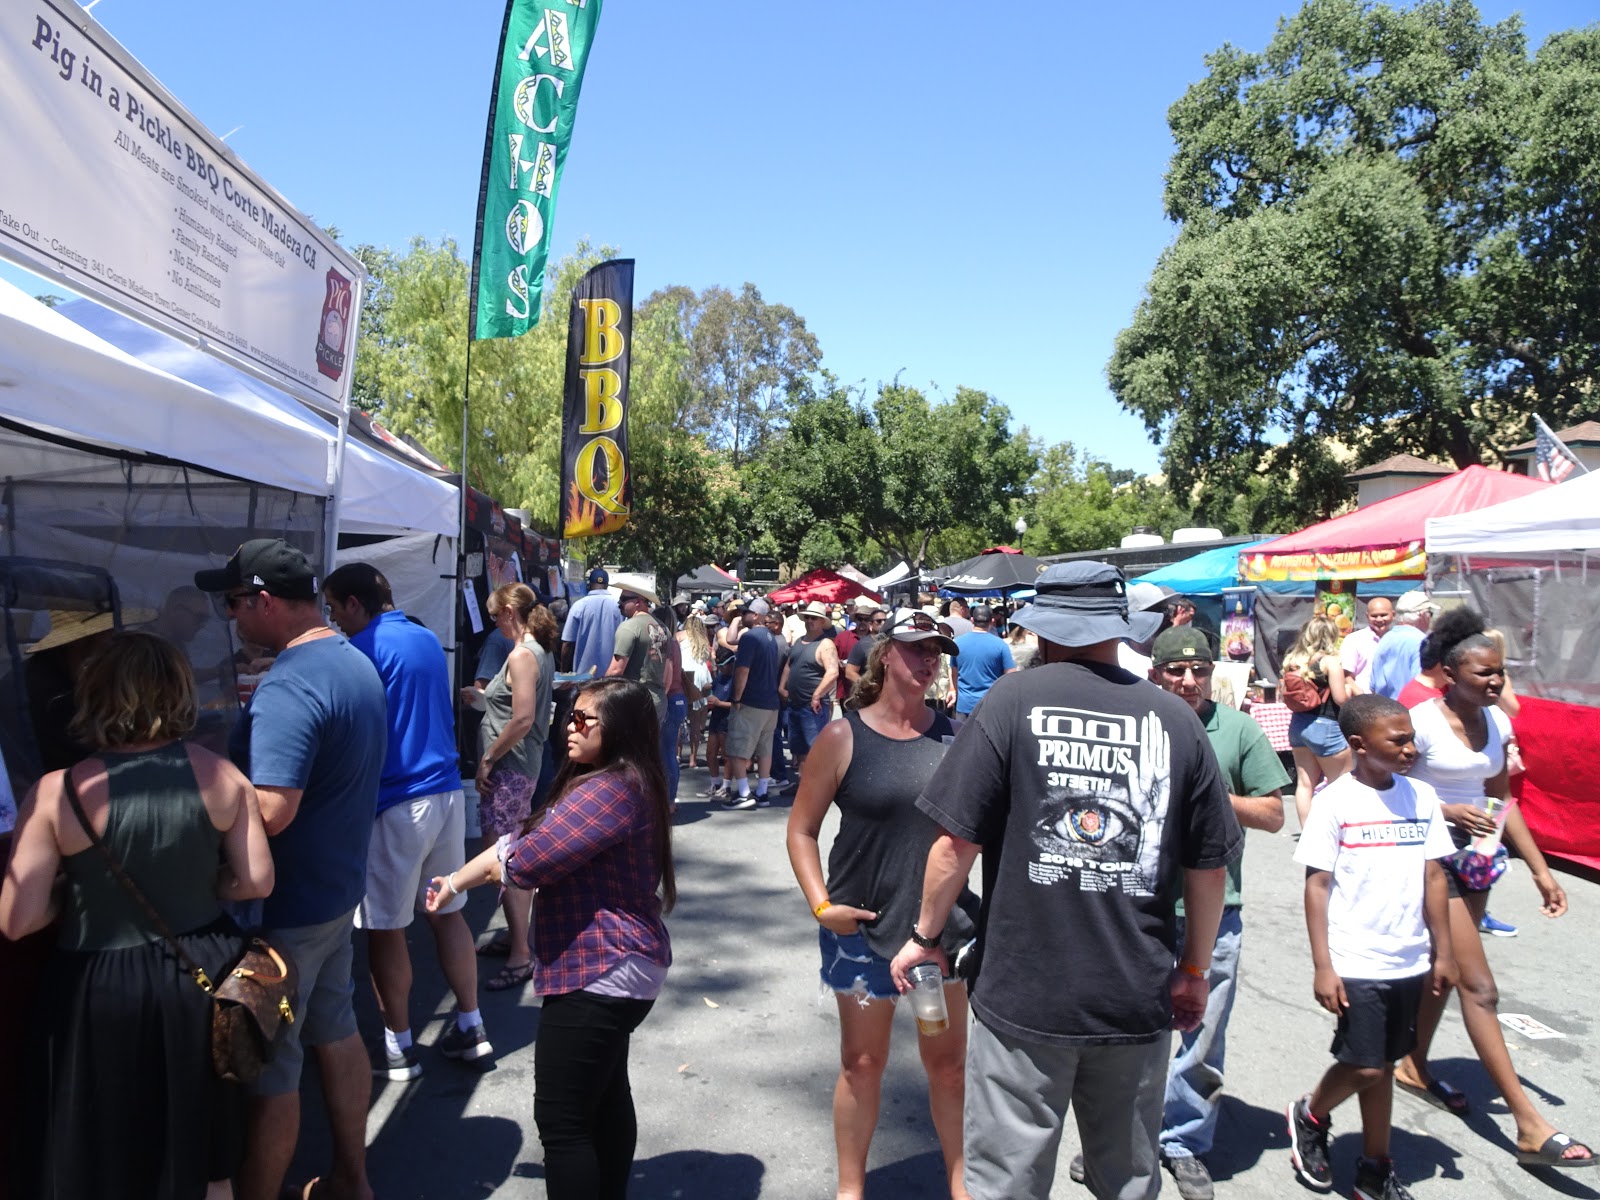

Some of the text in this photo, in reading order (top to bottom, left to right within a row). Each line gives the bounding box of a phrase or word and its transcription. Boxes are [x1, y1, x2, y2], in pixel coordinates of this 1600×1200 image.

[32, 14, 316, 270] Pig in a Pickle BBQ Corte Madera CA
[506, 0, 587, 318] ACHOS
[114, 129, 286, 269] All Meats are Smoked with California White Oak
[0, 209, 20, 231] Take
[22, 223, 40, 242] Out
[51, 238, 89, 270] Catering
[91, 259, 105, 276] 341
[106, 267, 128, 288] Corte
[128, 278, 155, 301] Madera
[176, 227, 230, 273] Family Ranches
[179, 206, 238, 259] Humanely Raised
[171, 269, 221, 308] No Antibiotics
[173, 248, 222, 289] No Hormones
[318, 342, 343, 368] PICKLE
[574, 297, 630, 515] BBQ
[1037, 739, 1132, 776] PRIMUS
[1361, 825, 1426, 840] HILFIGER
[1084, 858, 1142, 874] TOUR
